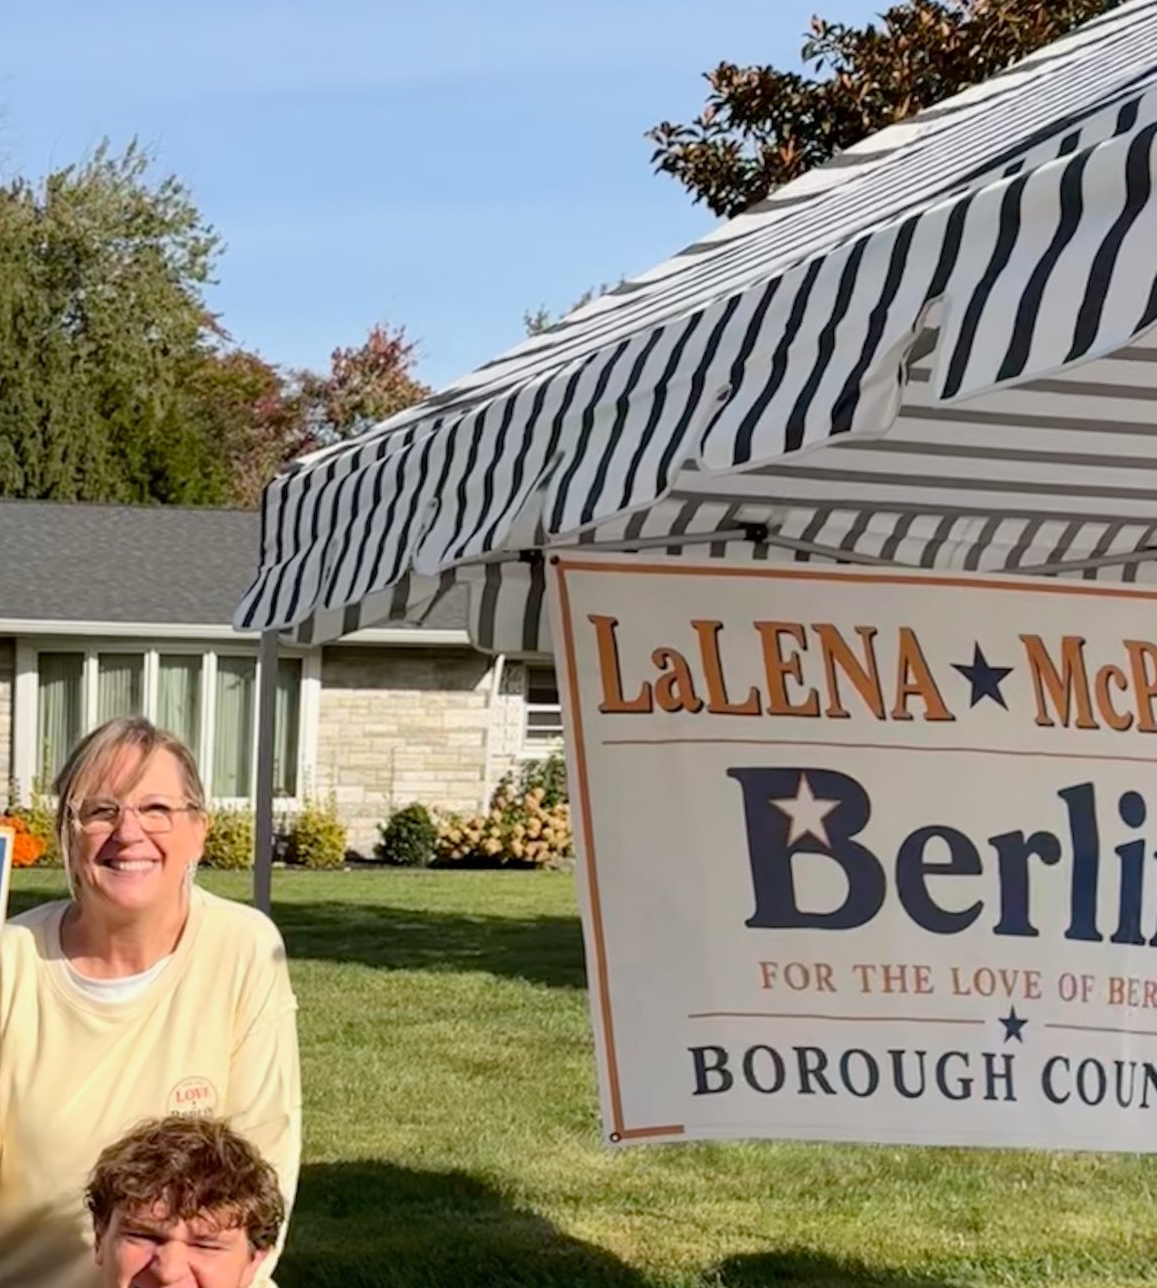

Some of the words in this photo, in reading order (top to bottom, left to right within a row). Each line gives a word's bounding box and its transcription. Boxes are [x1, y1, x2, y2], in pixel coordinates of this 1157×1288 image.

[588, 614, 955, 722] LaLENA
[1018, 634, 1157, 733] McP
[726, 767, 1157, 948] Berli
[759, 961, 836, 993] FOR
[853, 964, 934, 995] THE
[951, 967, 1042, 1000] LOVE
[1058, 972, 1095, 1002] OF
[688, 1044, 1017, 1103] BOROUGH
